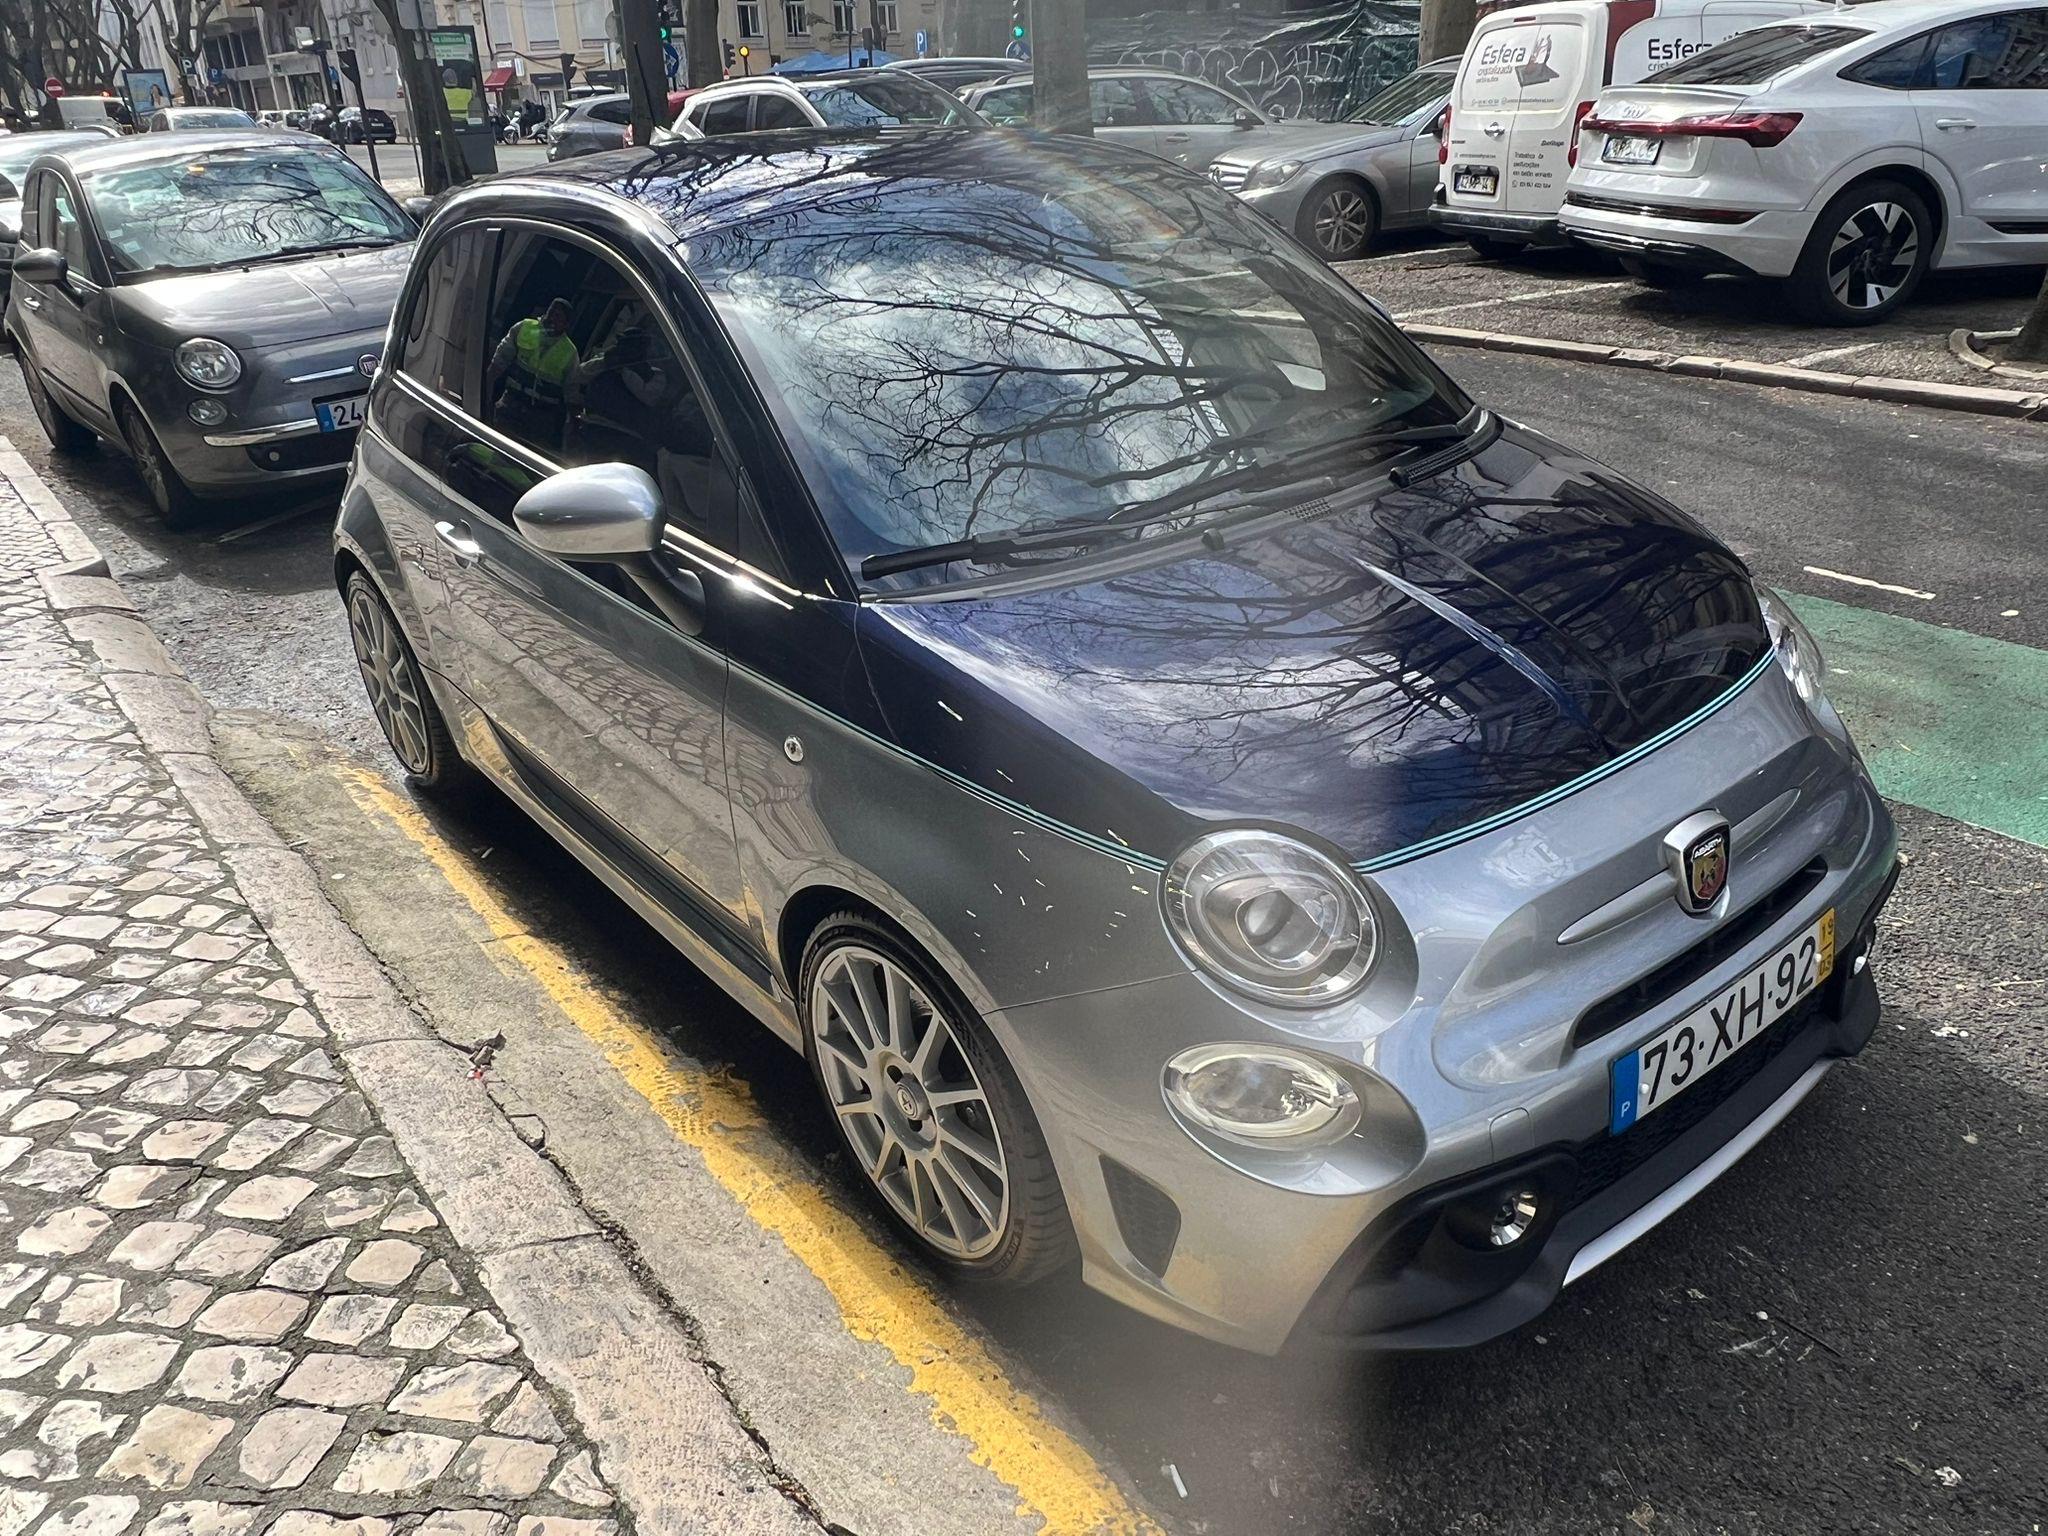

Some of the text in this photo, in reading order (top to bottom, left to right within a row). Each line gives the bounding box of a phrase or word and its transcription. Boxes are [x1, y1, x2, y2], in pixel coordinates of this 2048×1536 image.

[917, 32, 924, 51] P
[1648, 38, 1713, 59] Esfer
[1481, 43, 1526, 65] Esfera
[184, 59, 193, 75] P
[1621, 1101, 1631, 1118] P
